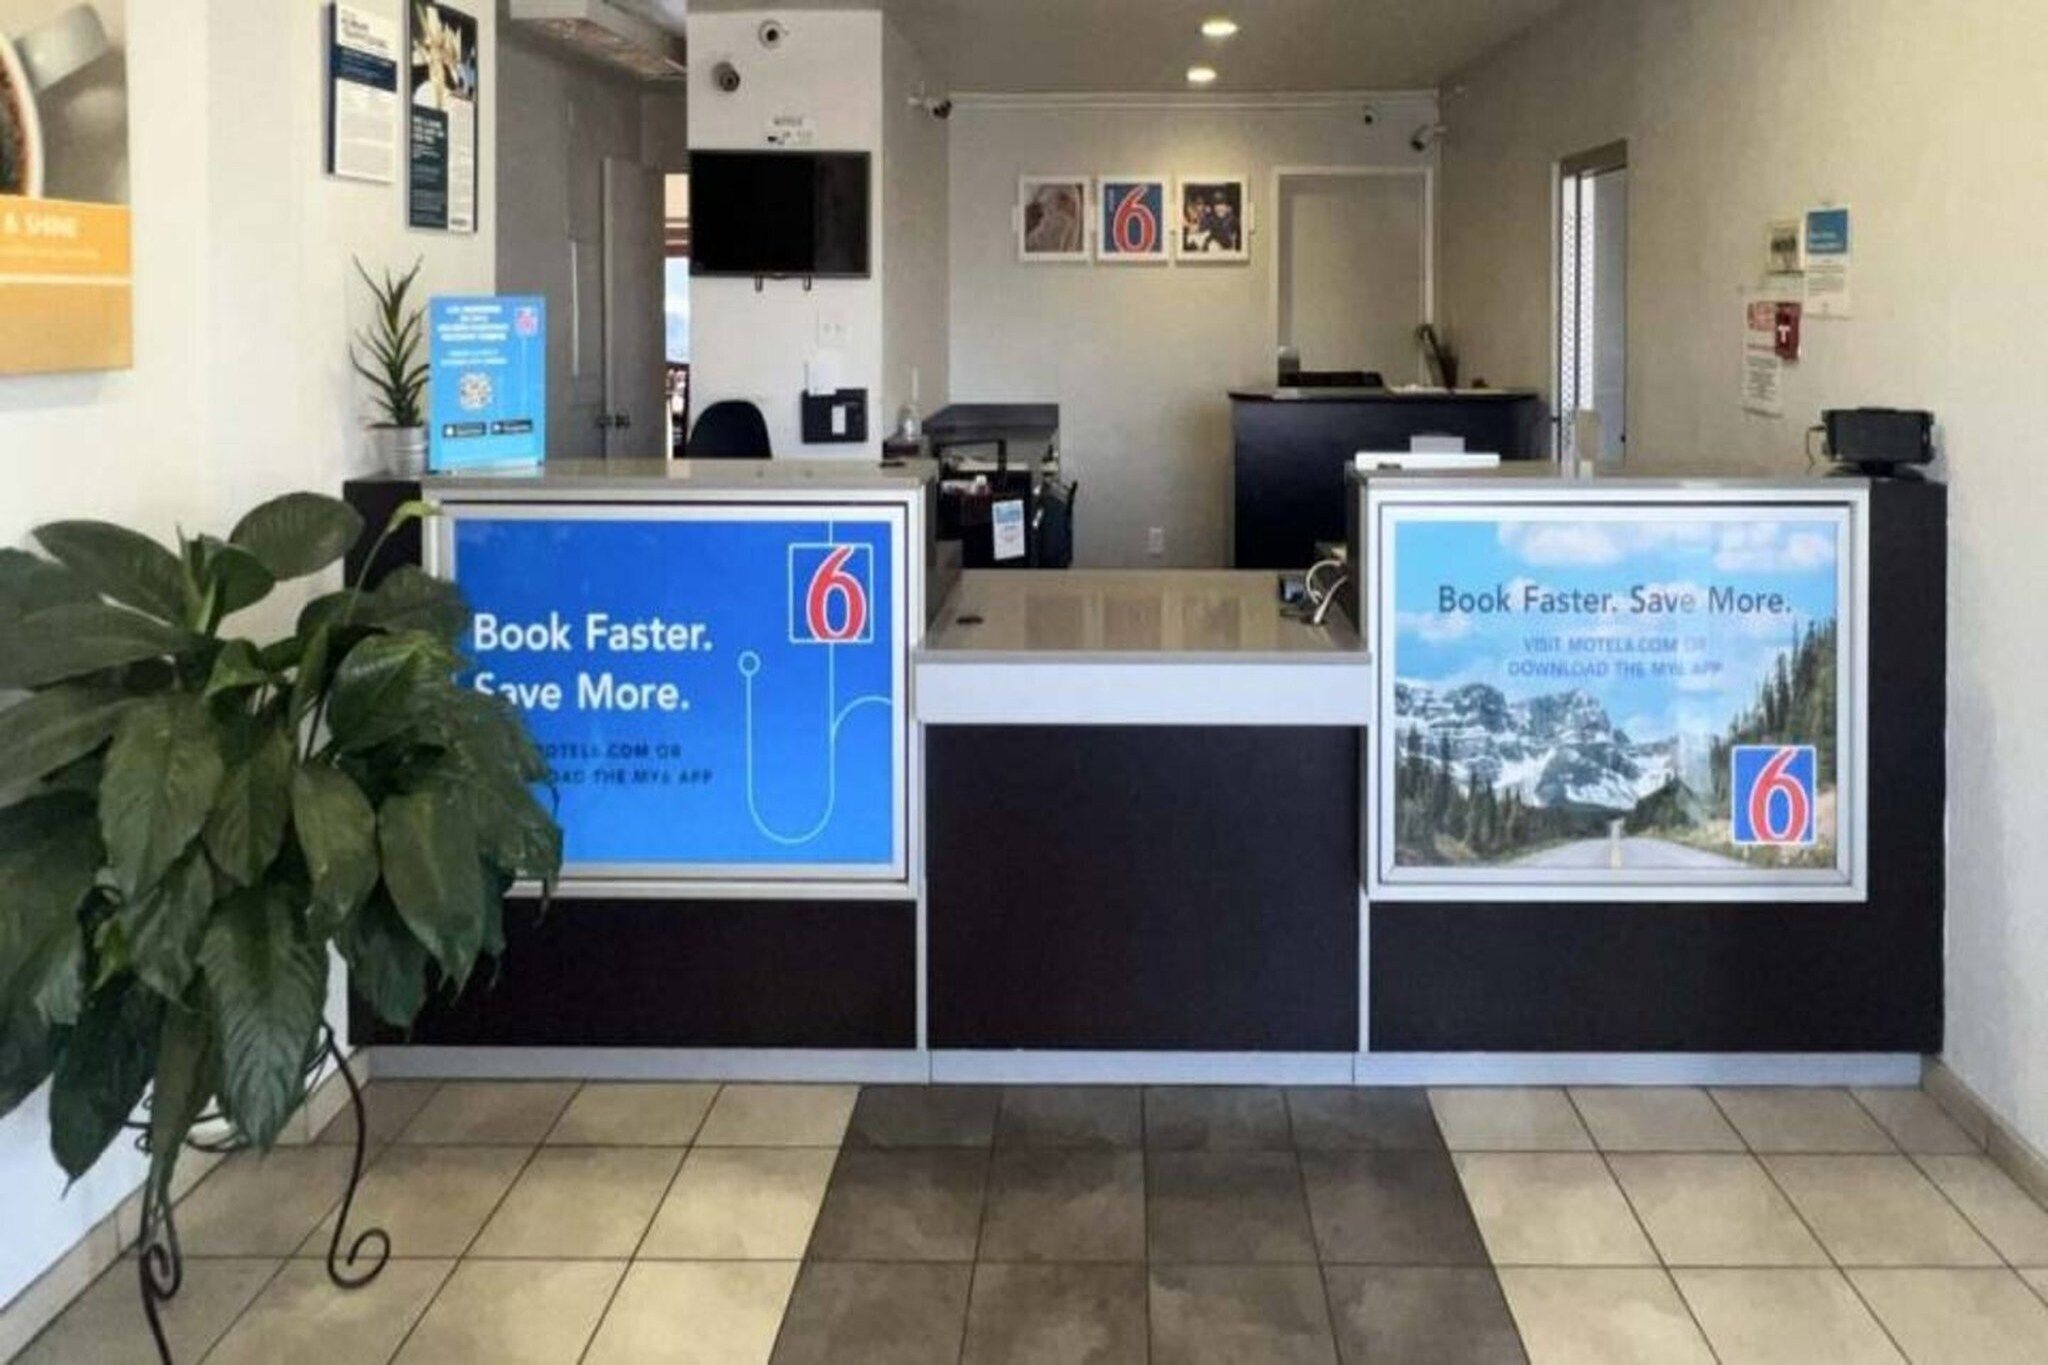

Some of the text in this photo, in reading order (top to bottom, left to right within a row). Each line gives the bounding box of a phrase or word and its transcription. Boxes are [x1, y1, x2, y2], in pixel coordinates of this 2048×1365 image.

[1112, 185, 1157, 254] 6
[805, 543, 868, 642] 6
[1438, 584, 1791, 614] Book Faster. Save More.
[473, 611, 713, 652] Book Faster.
[1523, 637, 1561, 652] VISIT
[1507, 660, 1609, 677] DOWNLOAD
[1615, 661, 1645, 677] THE
[577, 671, 690, 711] More.
[655, 743, 682, 759] OR
[594, 769, 626, 784] THE
[679, 768, 714, 784] APP
[1747, 745, 1810, 845] 6
